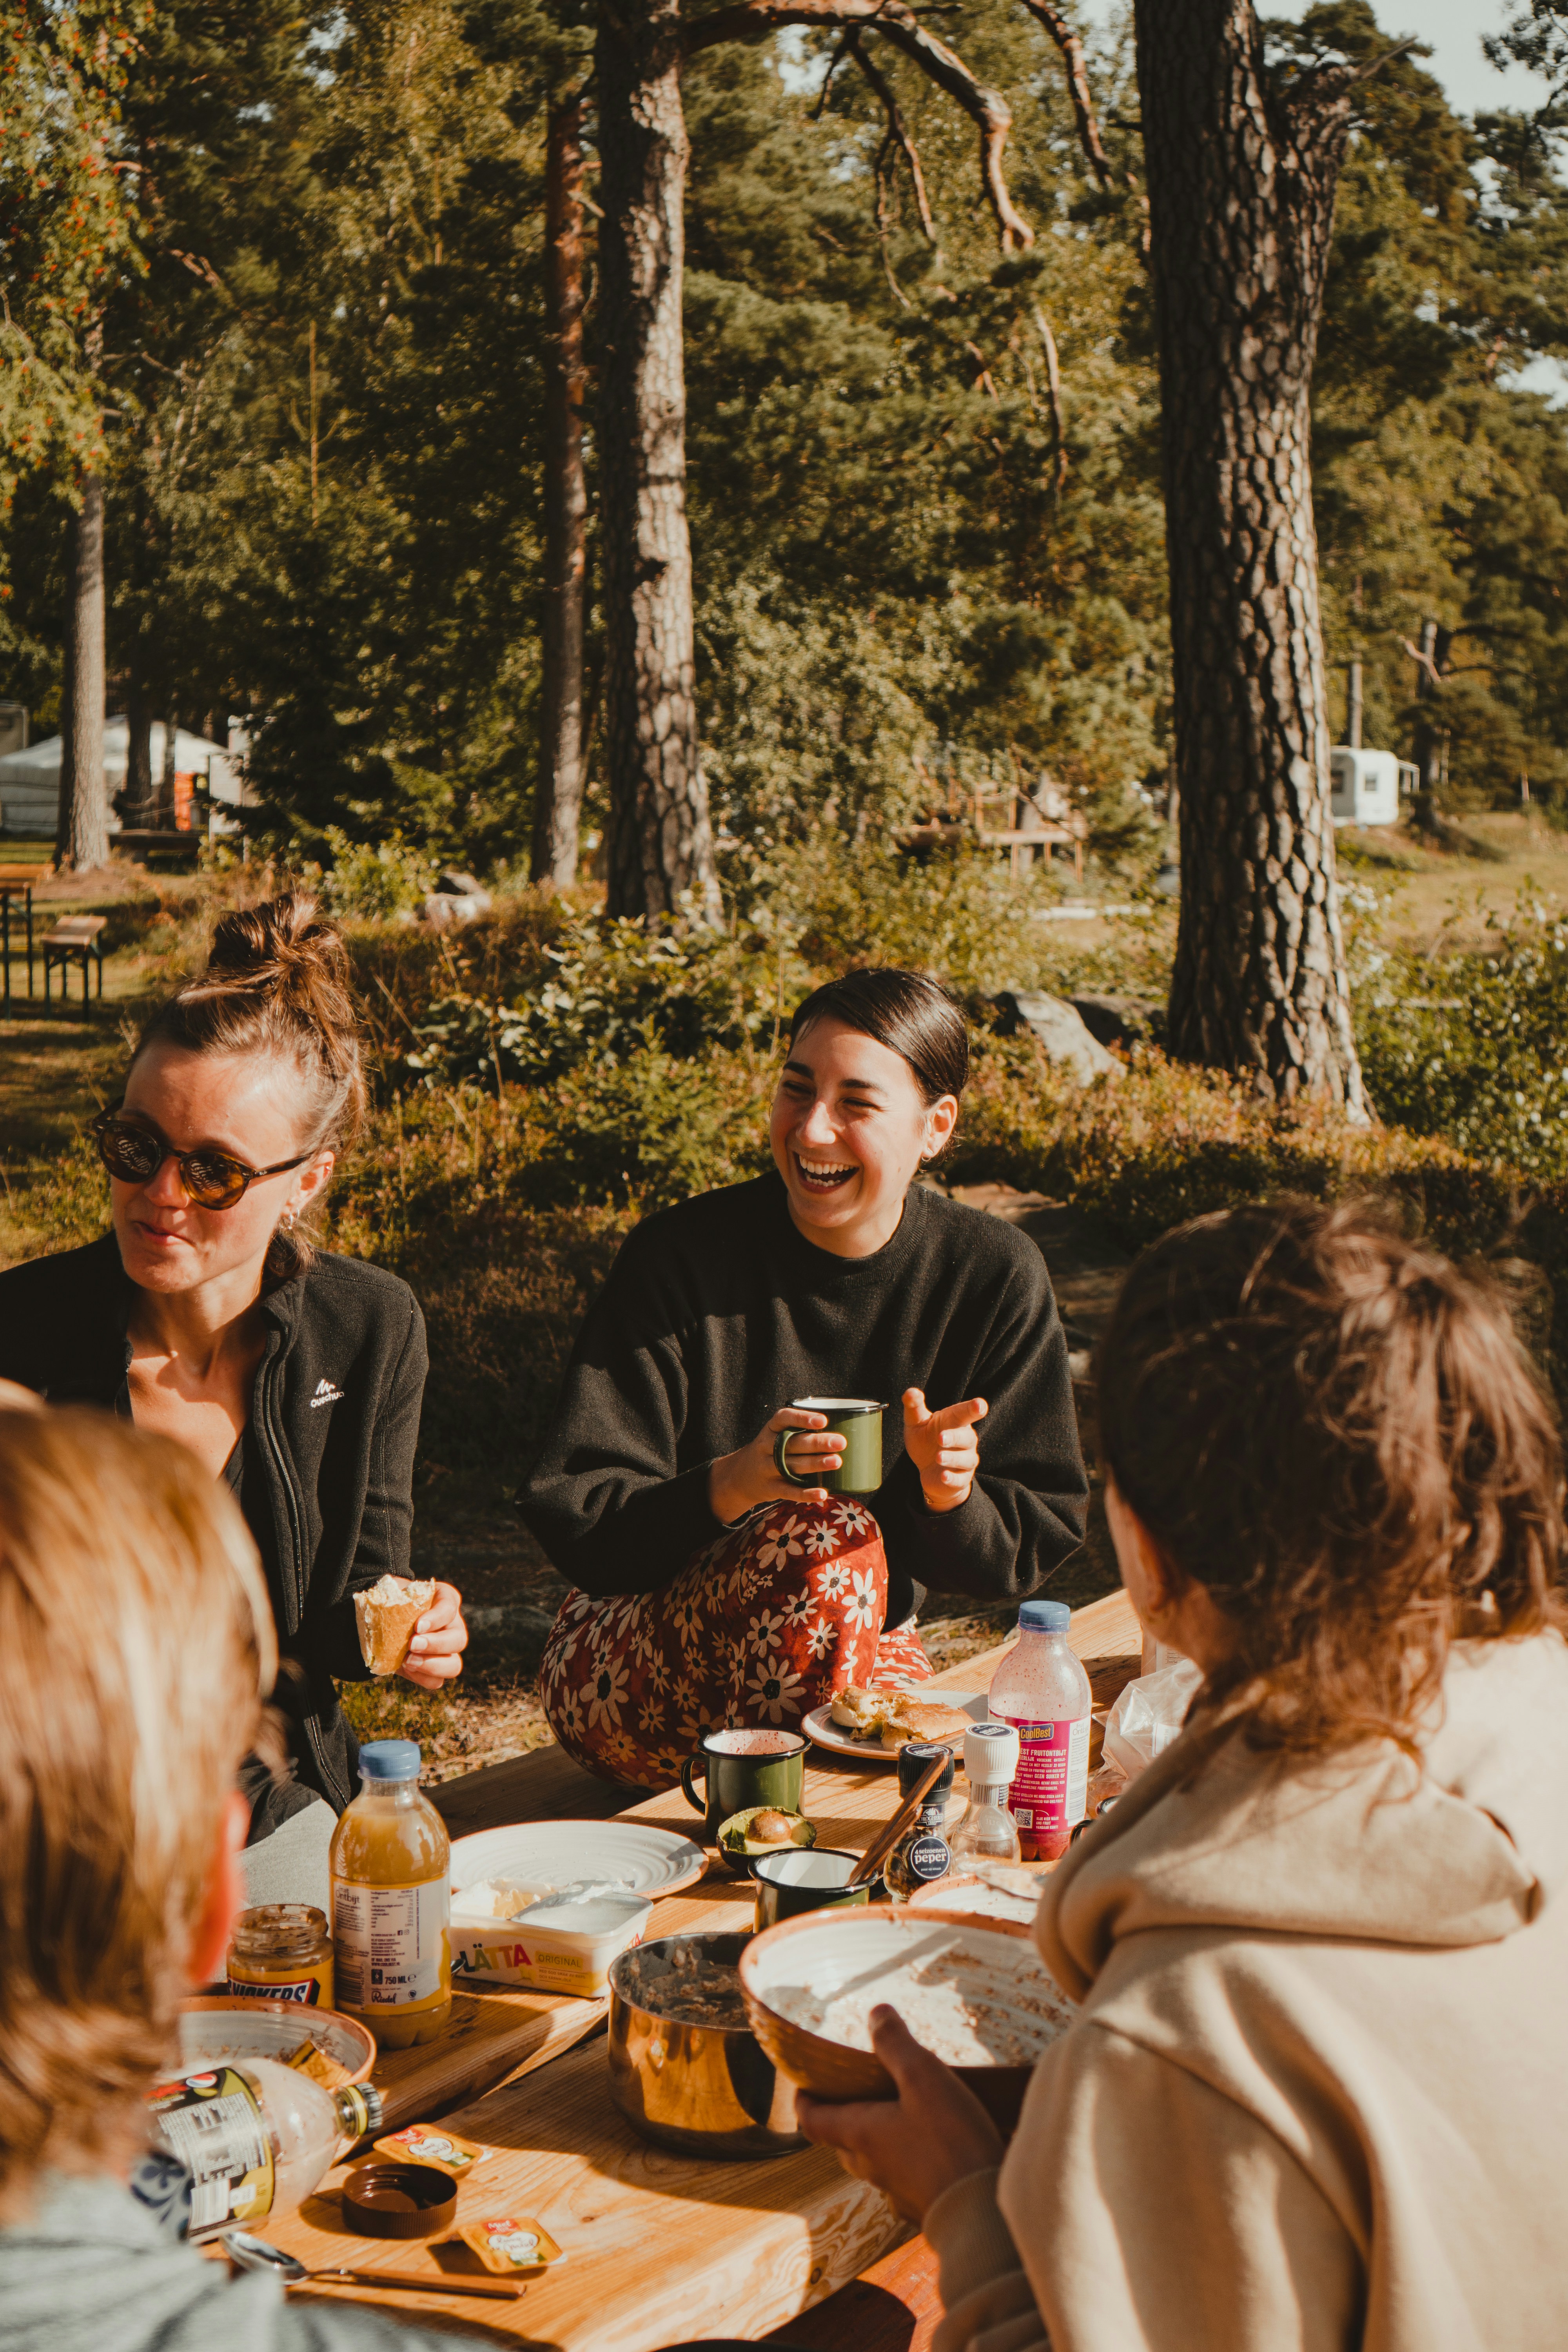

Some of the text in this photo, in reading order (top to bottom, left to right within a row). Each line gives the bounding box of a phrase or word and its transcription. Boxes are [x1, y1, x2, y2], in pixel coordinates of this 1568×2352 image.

[310, 1391, 345, 1408] Quechua
[1020, 1728, 1051, 1739] CoolBest
[914, 1853, 947, 1864] peper
[336, 1889, 360, 1905] Ontbijt
[459, 1943, 532, 1973] LÄTTA
[538, 1955, 581, 1968] ORIGINAL
[385, 1976, 396, 1985] 750
[397, 1976, 407, 1984] ML
